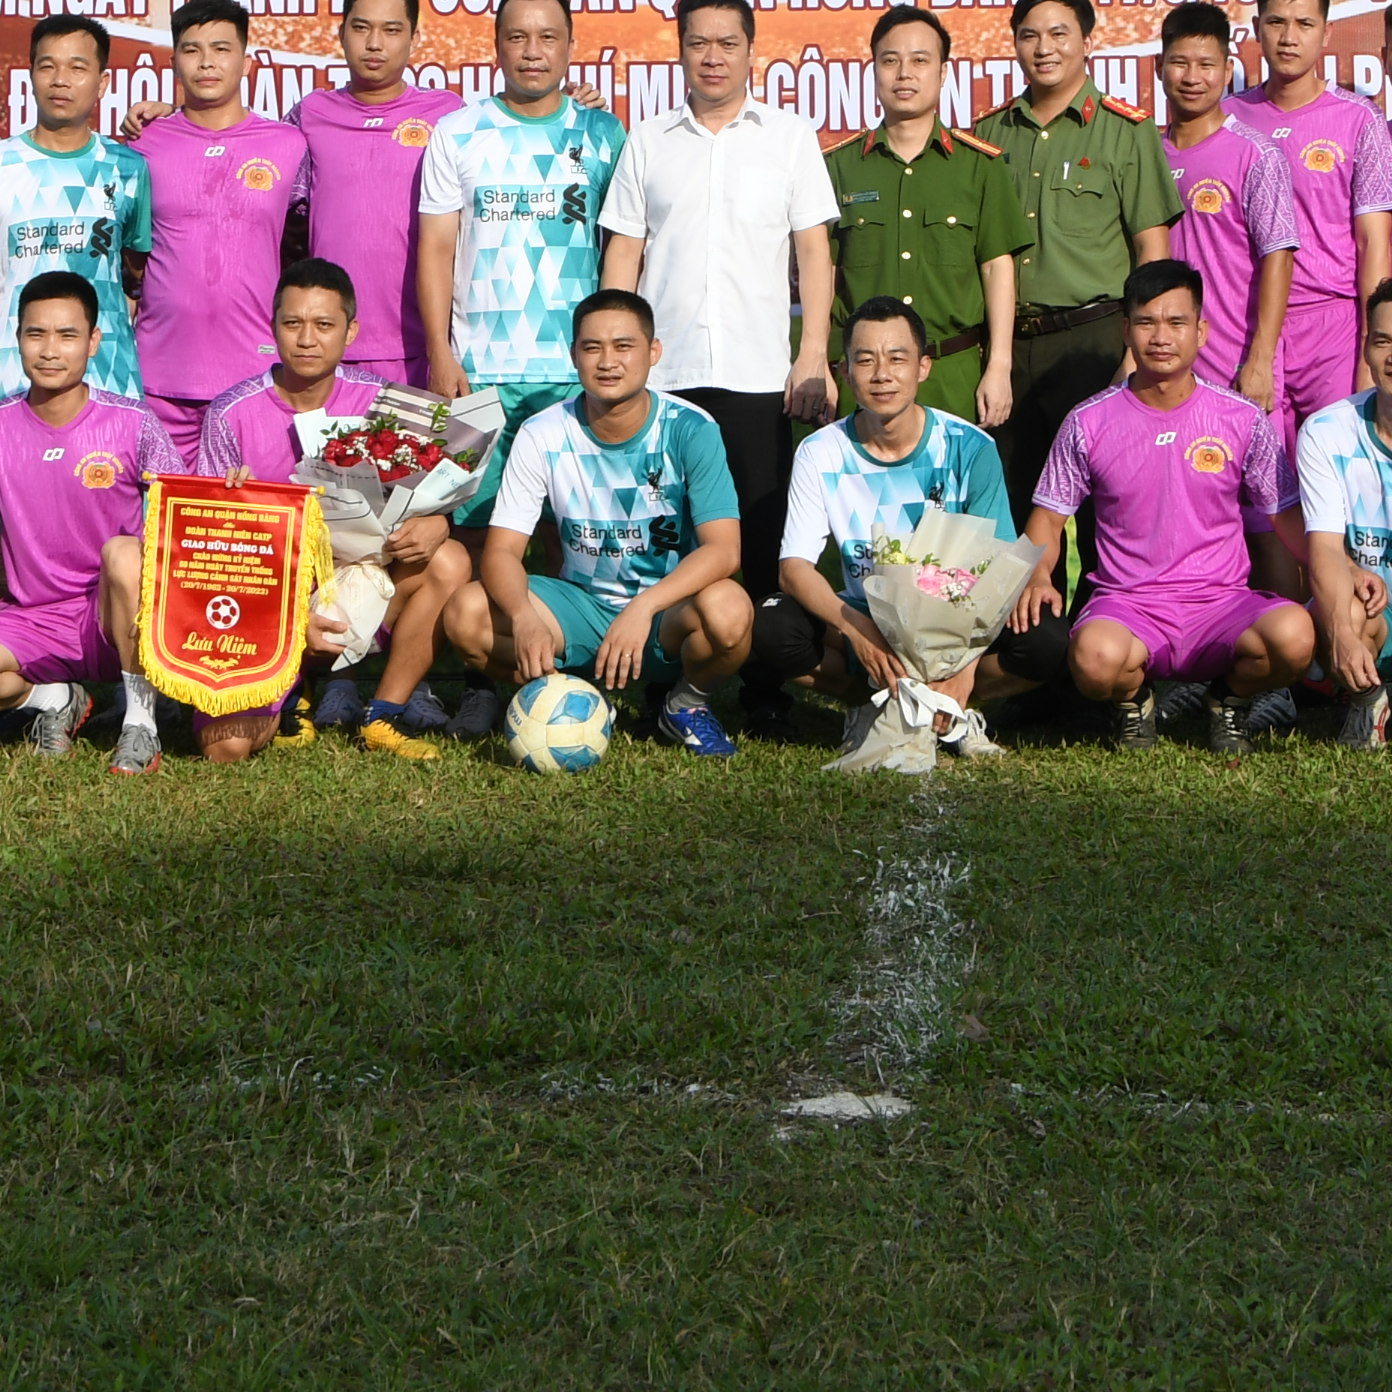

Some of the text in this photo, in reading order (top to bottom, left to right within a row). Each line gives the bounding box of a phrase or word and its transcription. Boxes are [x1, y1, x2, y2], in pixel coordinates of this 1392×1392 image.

[483, 189, 556, 205] Standard
[479, 207, 556, 223] Chartered
[17, 222, 85, 241] Standard
[15, 240, 83, 259] Chartered
[571, 524, 642, 541] Standard
[181, 539, 274, 555] GIAO HỮU BÓNG ĐÁ
[569, 540, 646, 559] Chartered
[182, 631, 258, 660] Lưu Niệm
